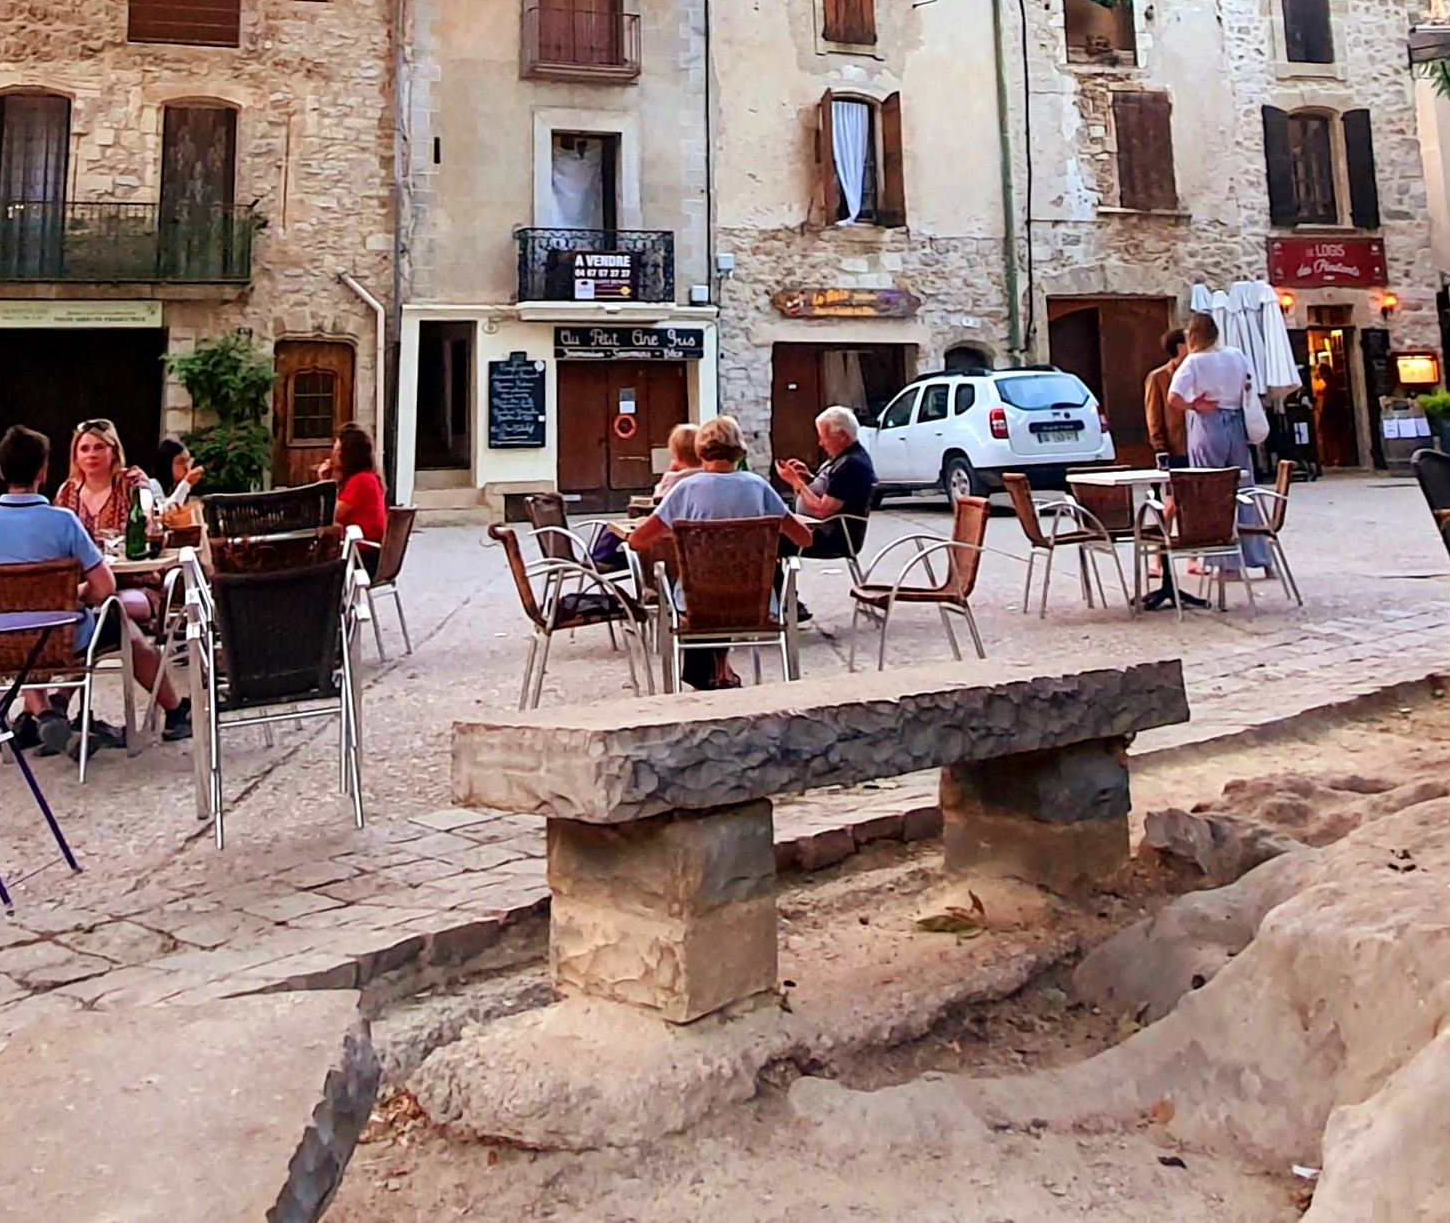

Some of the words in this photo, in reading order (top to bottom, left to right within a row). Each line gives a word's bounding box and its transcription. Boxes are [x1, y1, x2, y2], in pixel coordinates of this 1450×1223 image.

[1315, 244, 1346, 257] LOGIS
[575, 255, 584, 267] A
[585, 255, 631, 267] VENDRE
[590, 328, 620, 347] Petit
[667, 328, 697, 348] Gris
